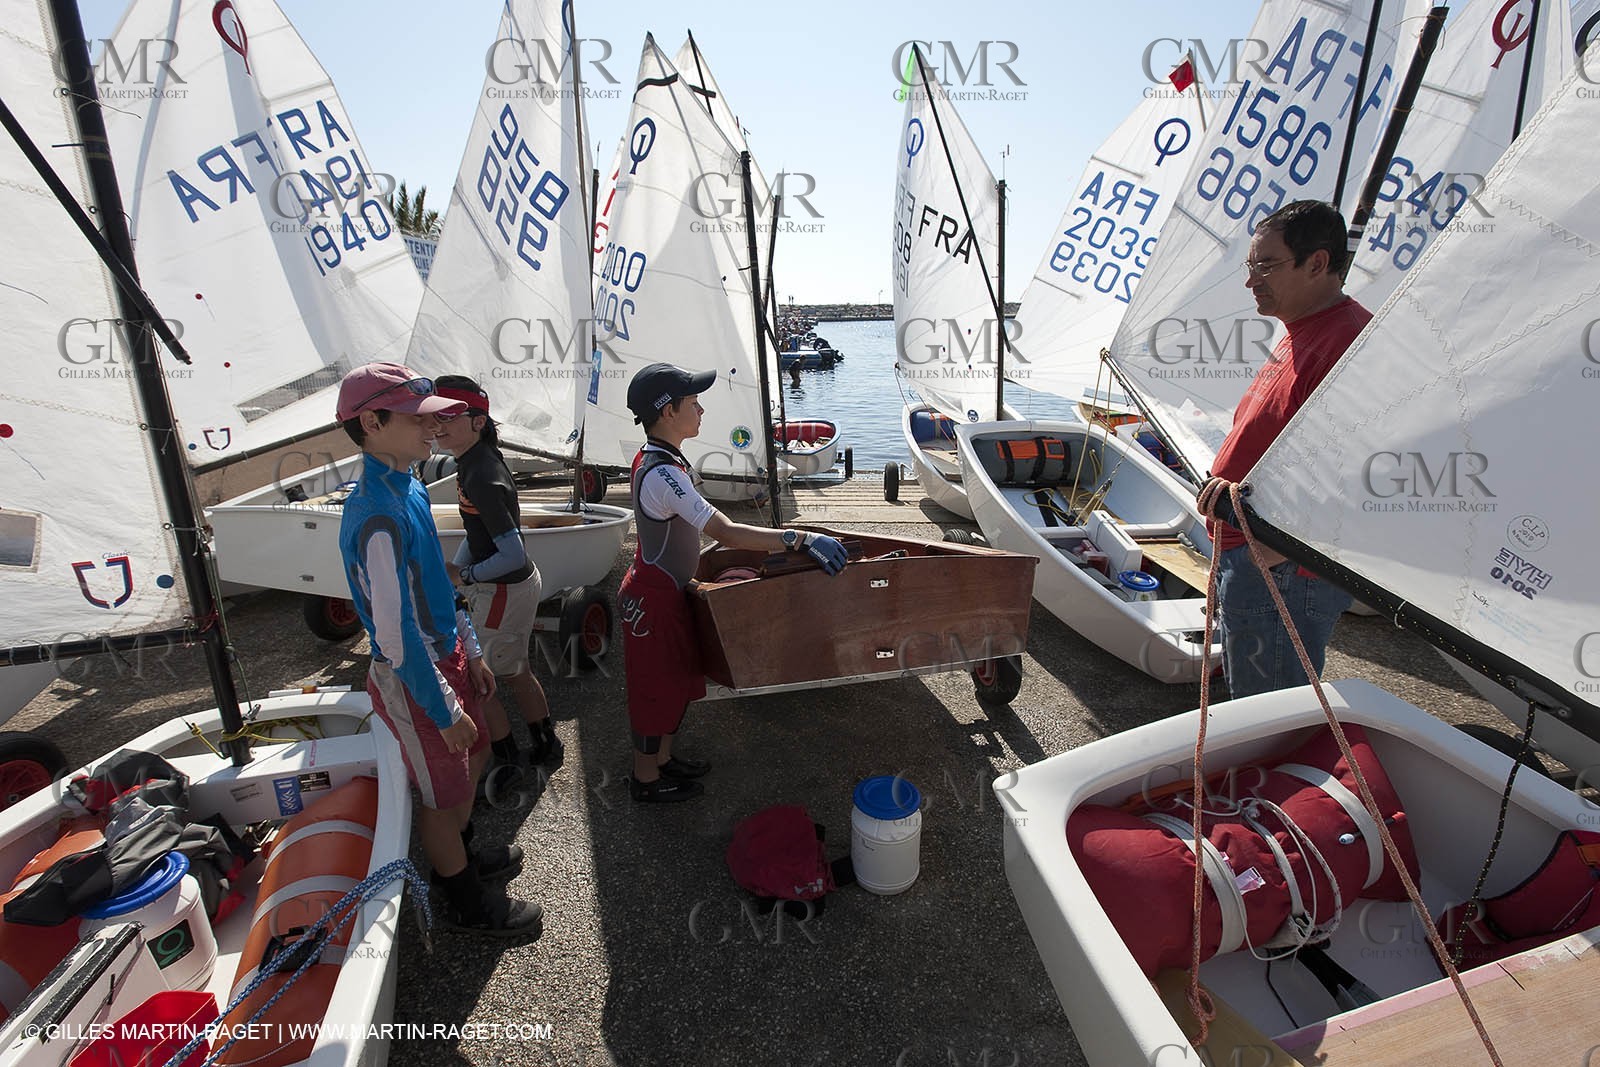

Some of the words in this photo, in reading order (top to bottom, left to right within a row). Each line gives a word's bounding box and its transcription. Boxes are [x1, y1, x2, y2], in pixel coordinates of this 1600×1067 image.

[1222, 79, 1332, 186] 1586
[305, 200, 391, 277] 1940
[918, 204, 973, 264] FRA
